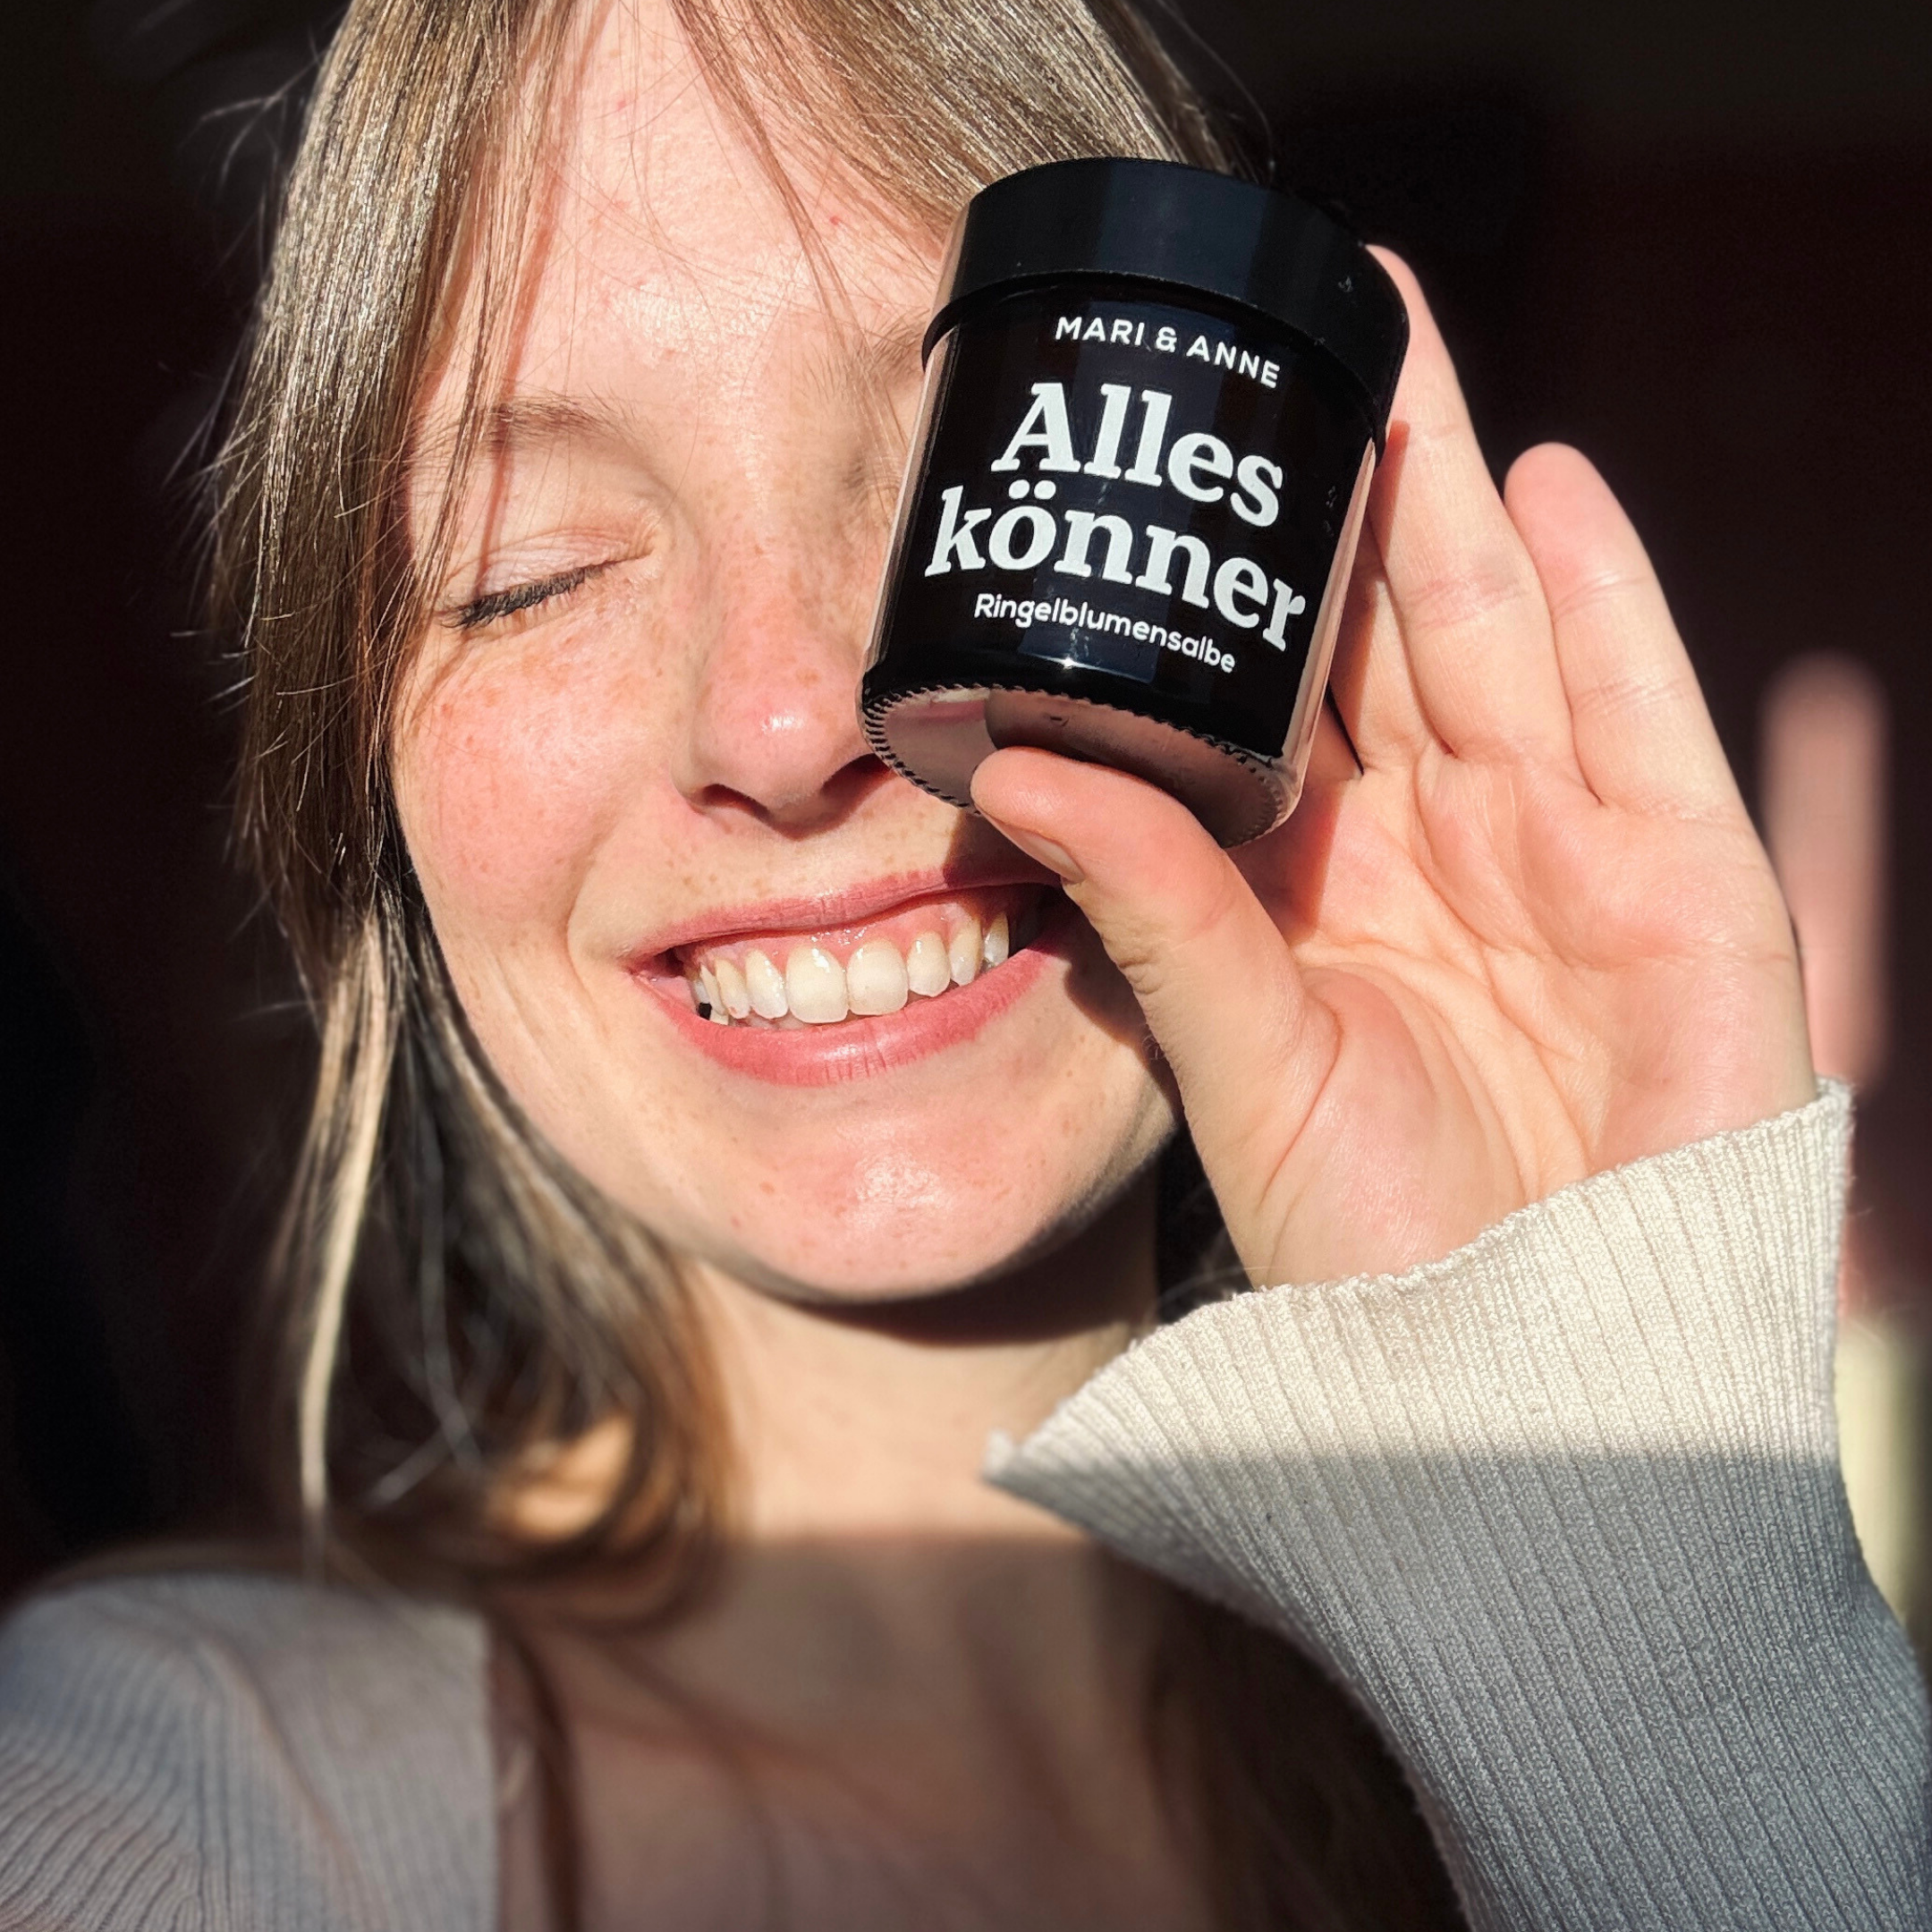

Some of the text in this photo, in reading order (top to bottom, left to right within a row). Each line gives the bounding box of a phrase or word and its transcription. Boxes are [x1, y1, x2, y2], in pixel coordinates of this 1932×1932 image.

[1055, 316, 1281, 389] MARI & ANNE
[990, 382, 1284, 528] Alles
[923, 485, 1306, 652] könner
[973, 593, 1236, 674] Ringelblumensalbe
